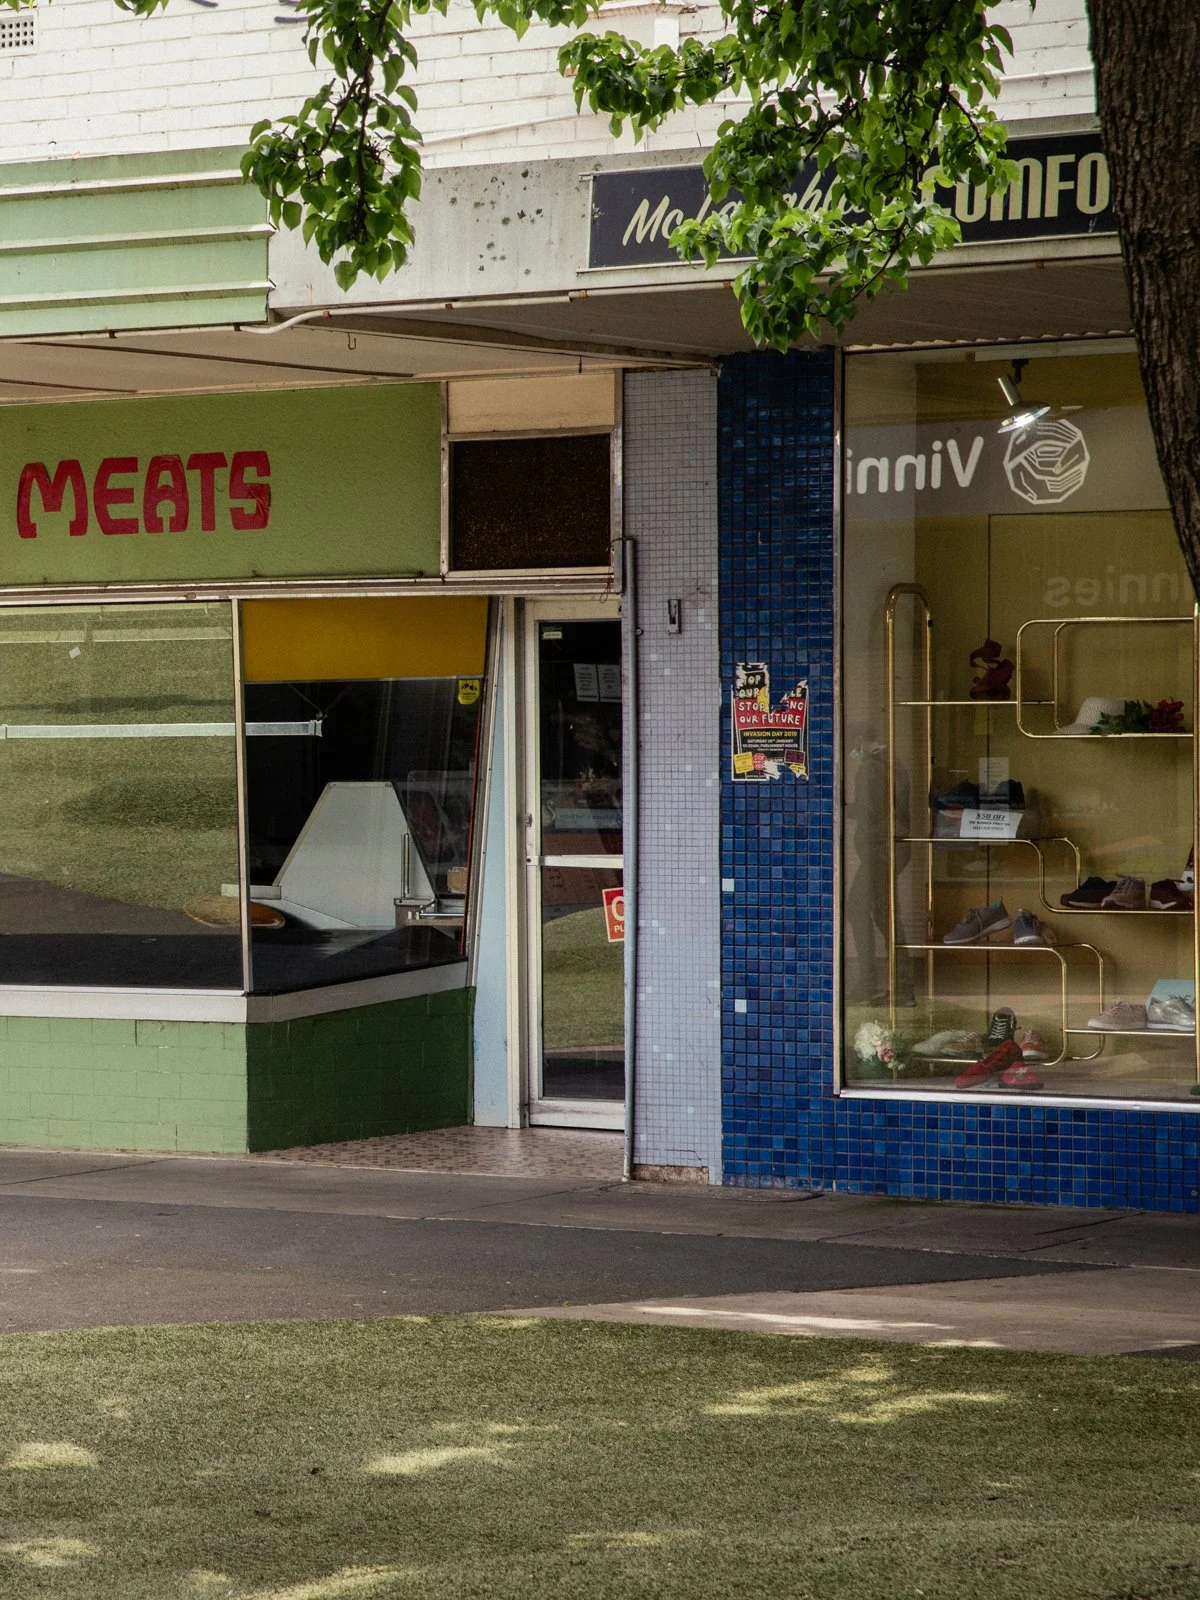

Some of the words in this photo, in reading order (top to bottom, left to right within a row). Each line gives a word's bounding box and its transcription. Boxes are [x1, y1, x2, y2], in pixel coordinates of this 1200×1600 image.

[921, 152, 1112, 222] COMFO
[16, 450, 272, 539] MEATS
[738, 702, 765, 711] STOP
[739, 715, 759, 723] OUR
[762, 714, 800, 725] FUTURE
